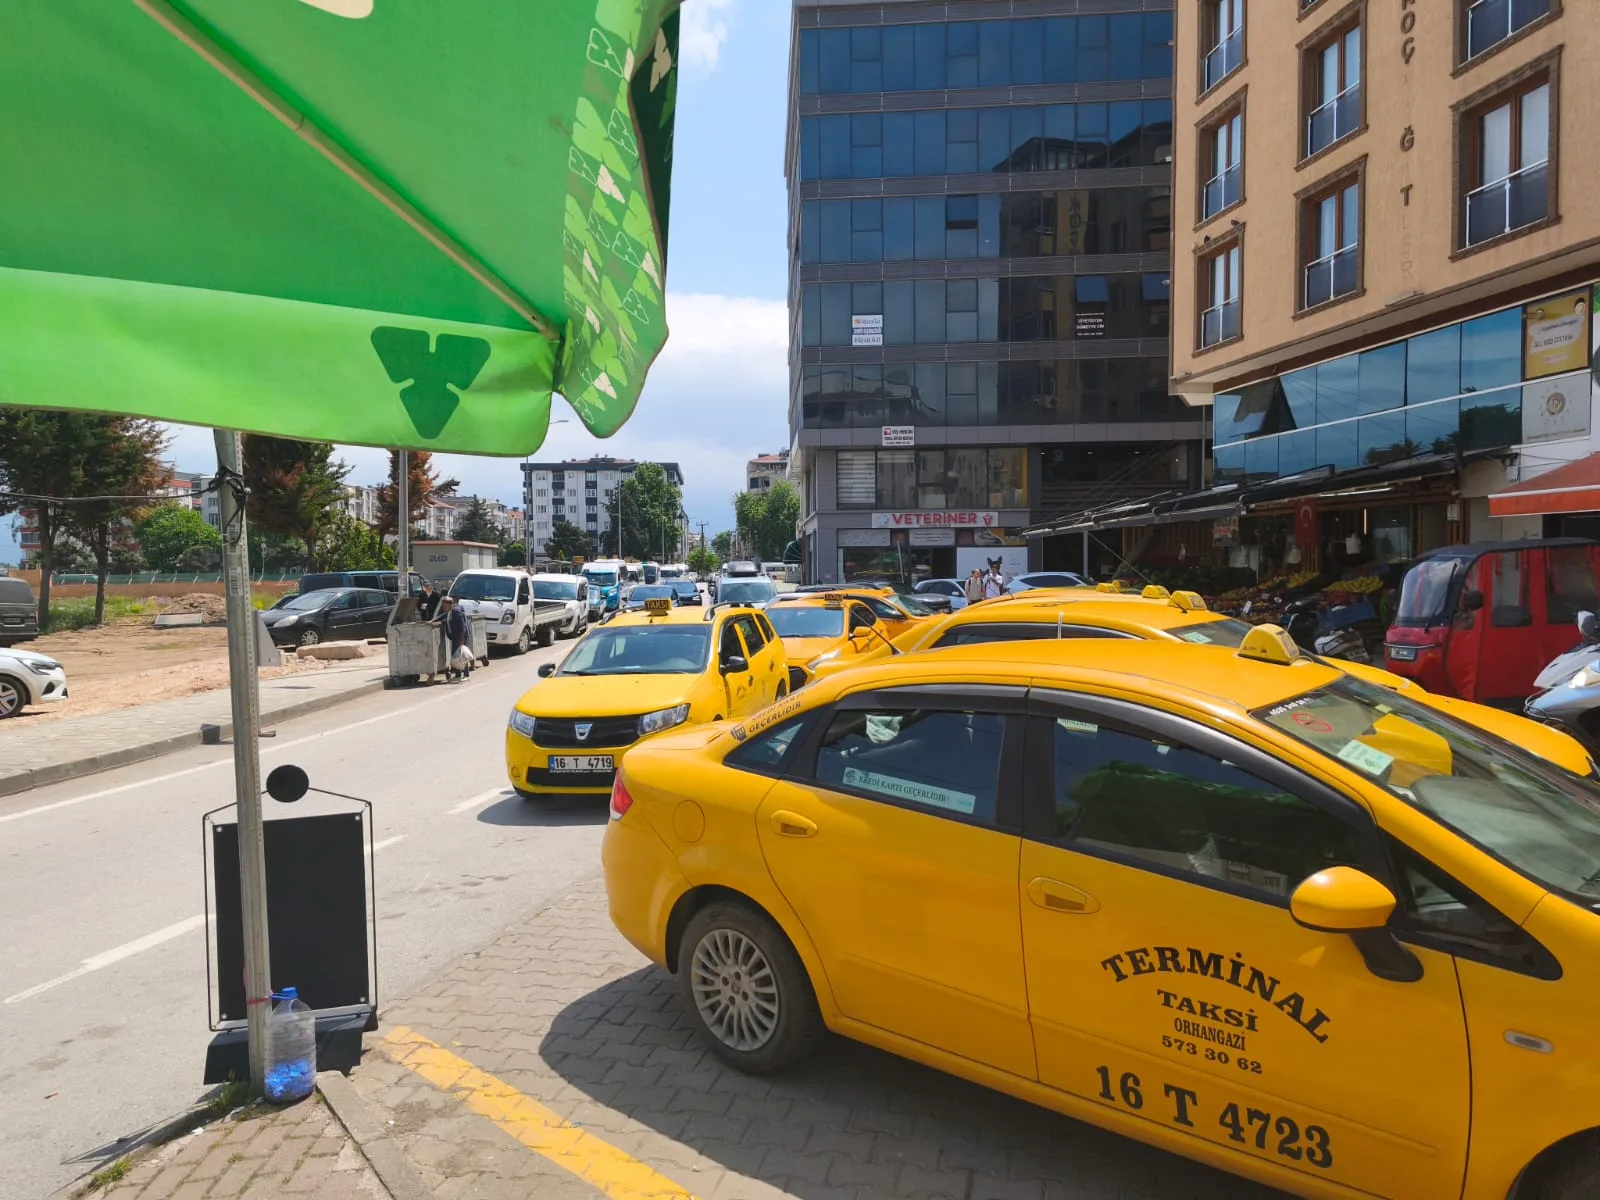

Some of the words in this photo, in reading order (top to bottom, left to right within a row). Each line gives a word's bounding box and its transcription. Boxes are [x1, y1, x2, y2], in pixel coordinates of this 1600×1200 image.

[892, 512, 977, 525] VETERİNER
[555, 757, 566, 768] 16
[573, 757, 580, 768] T
[587, 757, 612, 768] 4719
[858, 774, 880, 787] KREDİ
[880, 780, 903, 793] KARTI
[1101, 946, 1331, 1044] TERMİNAL
[1157, 989, 1258, 1032] TAKSİ
[1174, 1017, 1246, 1051] ORHANGAZİ
[1161, 1035, 1198, 1056] 573
[1204, 1048, 1230, 1065] 30
[1236, 1056, 1263, 1075] 62
[1096, 1065, 1144, 1110] 16
[1163, 1082, 1198, 1128] T
[1219, 1102, 1333, 1169] 4723
